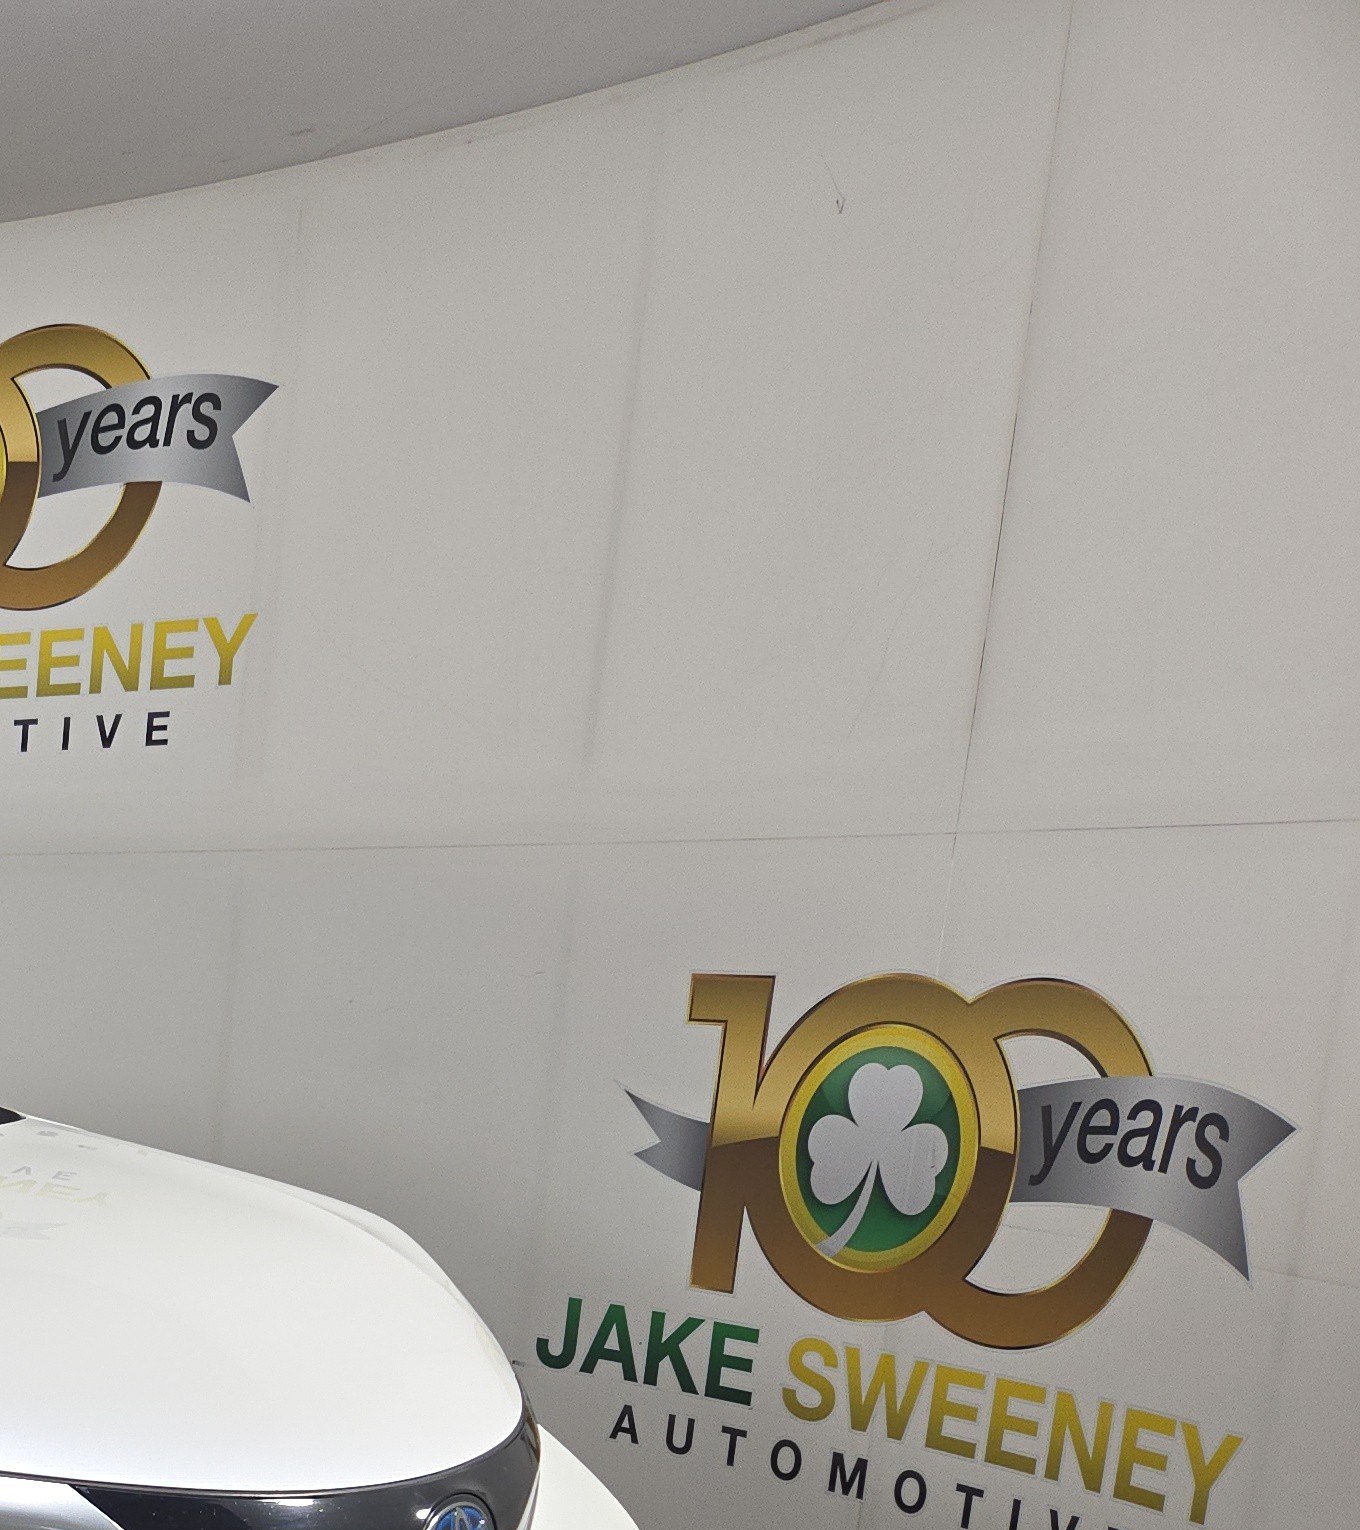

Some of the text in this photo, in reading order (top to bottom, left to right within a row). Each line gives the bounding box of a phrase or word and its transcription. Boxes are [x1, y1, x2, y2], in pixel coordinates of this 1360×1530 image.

[52, 390, 222, 482] years
[688, 972, 1231, 1350] 100 years
[535, 1296, 1244, 1526] JAKE SWEENEY
